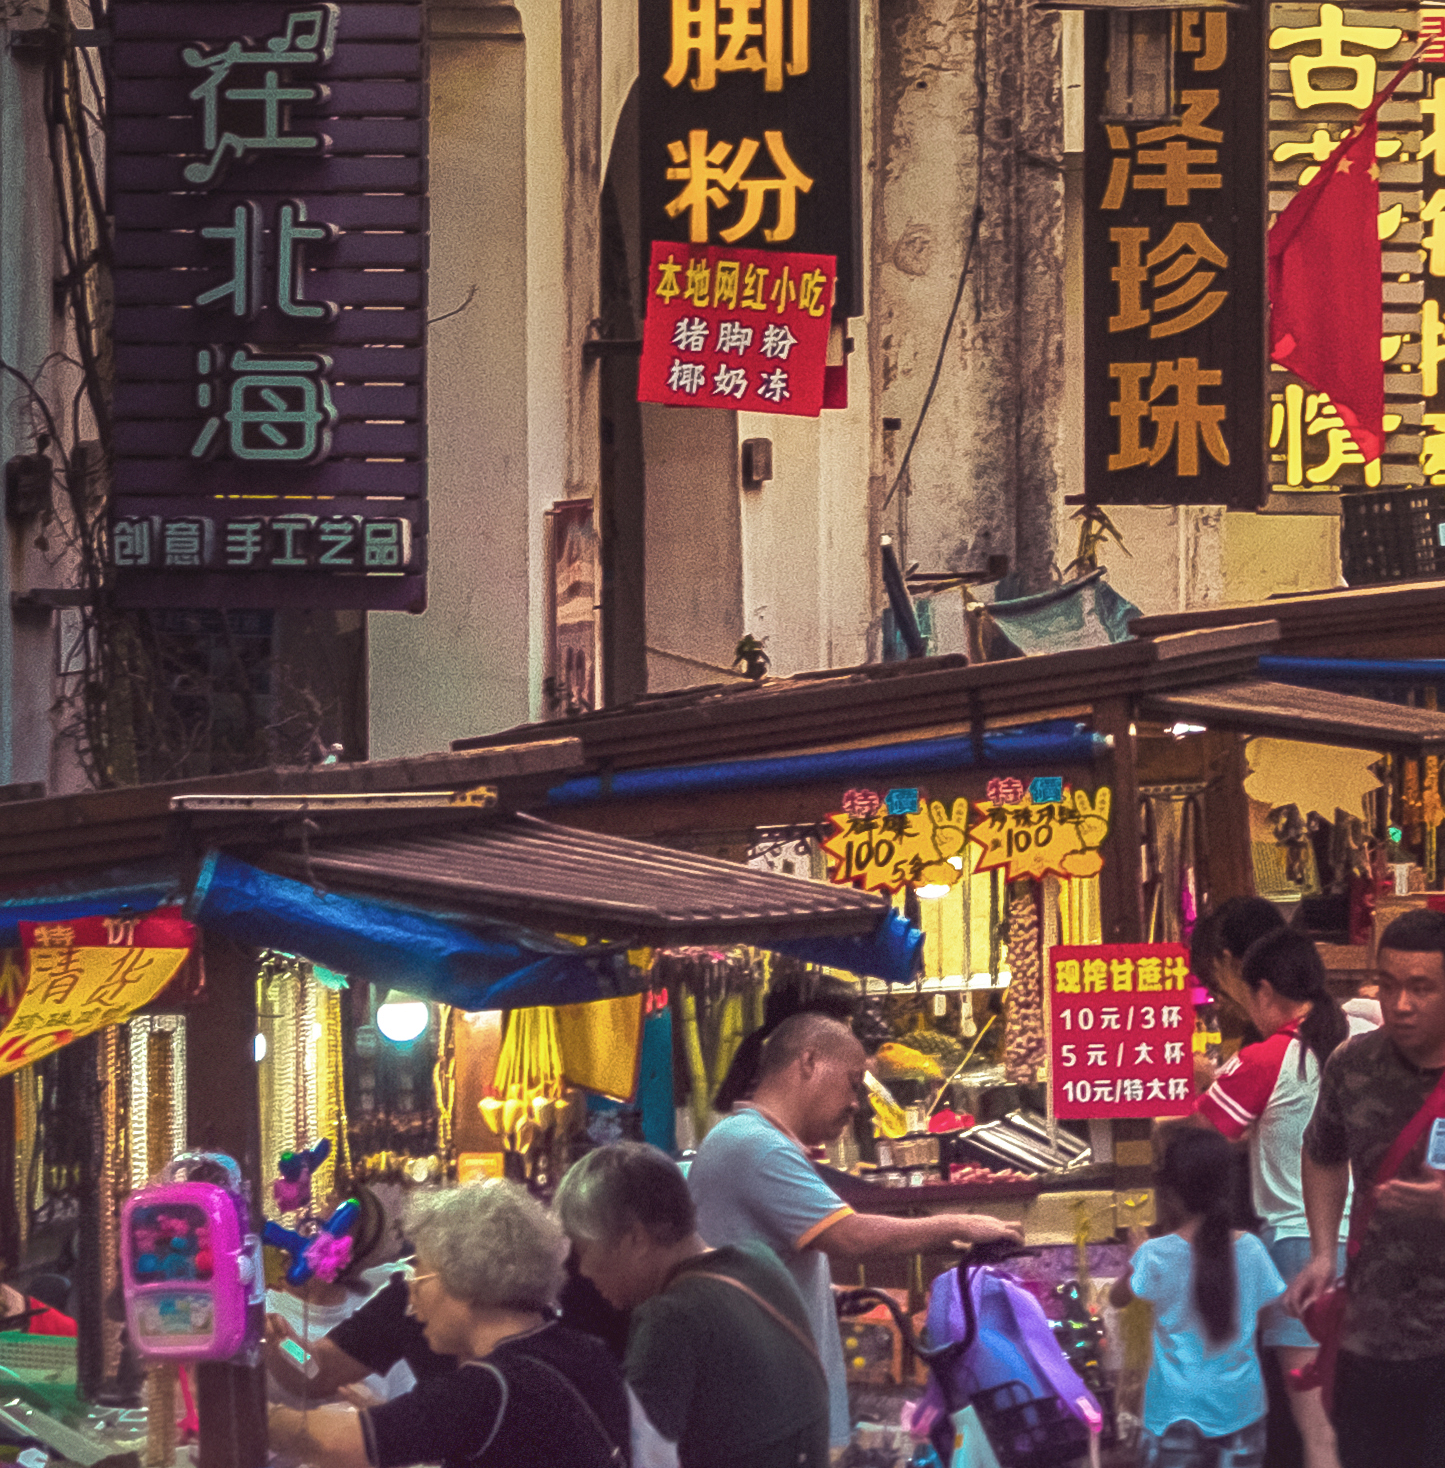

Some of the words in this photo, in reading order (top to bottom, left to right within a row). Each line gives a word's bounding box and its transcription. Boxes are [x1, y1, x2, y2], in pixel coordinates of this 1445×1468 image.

[655, 254, 826, 317] 本地网红小吃
[671, 317, 798, 361] 猪脚粉
[667, 358, 792, 404] 椰奶冻
[226, 516, 405, 568] 手工艺品
[845, 838, 896, 879] 100
[1006, 824, 1054, 858] 100
[1055, 956, 1189, 993] 现榨甘蔗汁
[1060, 1005, 1182, 1031] 10元/3杯
[1061, 1041, 1185, 1067] 5元/大杯
[1062, 1077, 1189, 1103] 10元/特大杯
